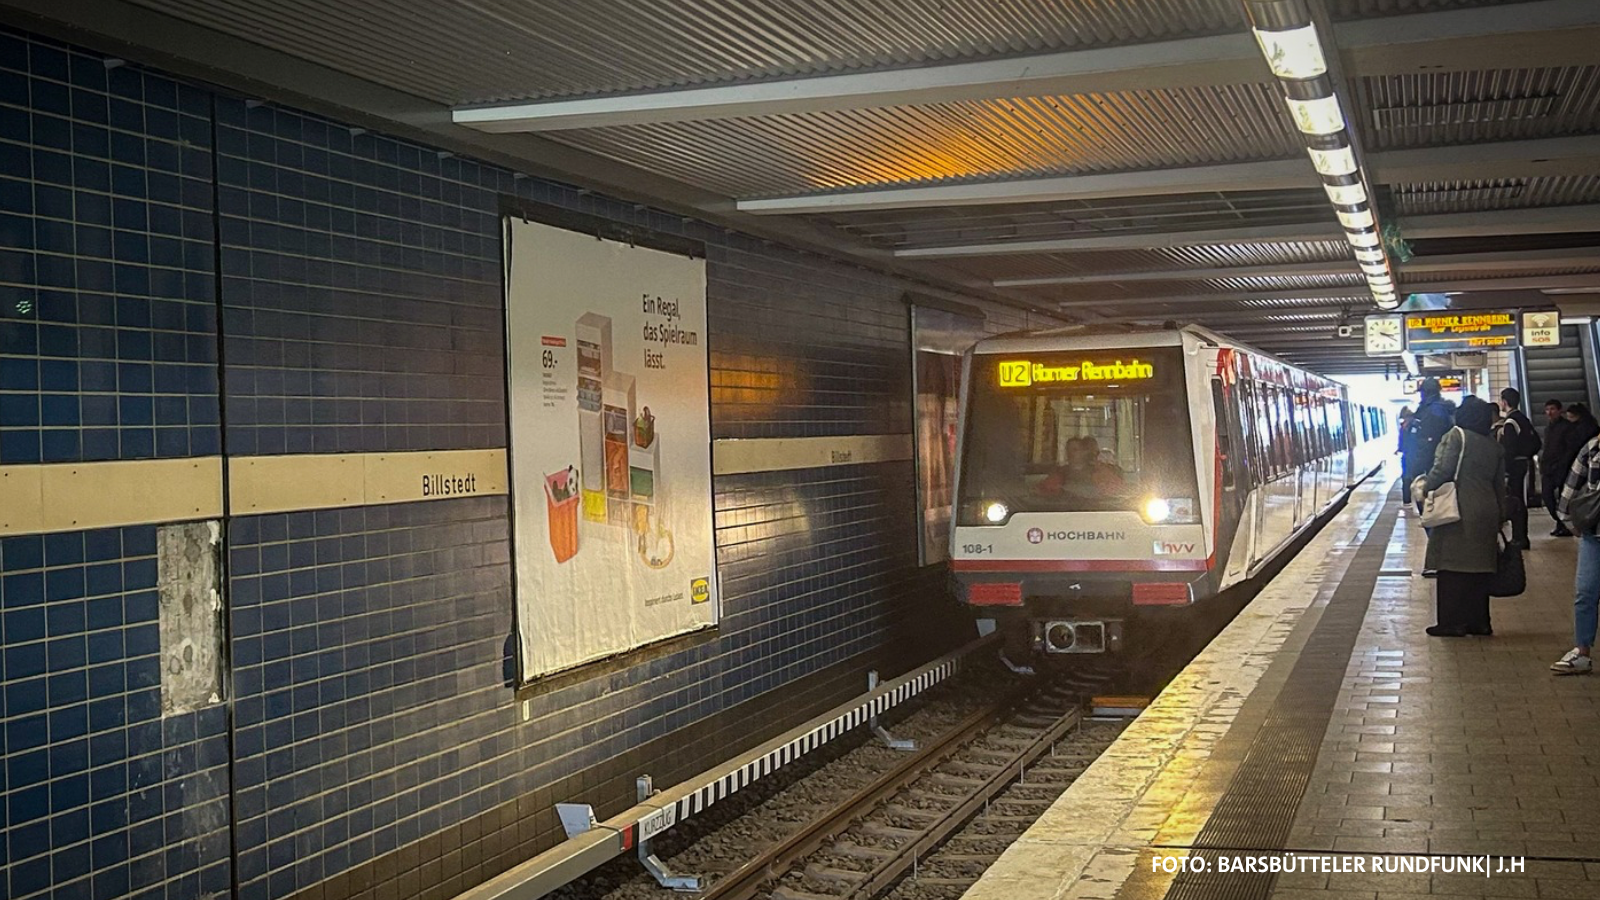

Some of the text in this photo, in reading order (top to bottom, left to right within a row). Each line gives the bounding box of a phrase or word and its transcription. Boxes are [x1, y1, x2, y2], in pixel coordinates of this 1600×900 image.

[643, 294, 681, 322] Ein Regal,
[643, 321, 697, 347] das Spielraum
[644, 349, 666, 369] lässt.
[1001, 360, 1153, 384] U2 Horner Rennbahn
[422, 473, 476, 496] Billstedt
[1047, 530, 1125, 540] HOCHBAHN
[962, 544, 993, 553] 108-1
[1162, 540, 1195, 553] hvv
